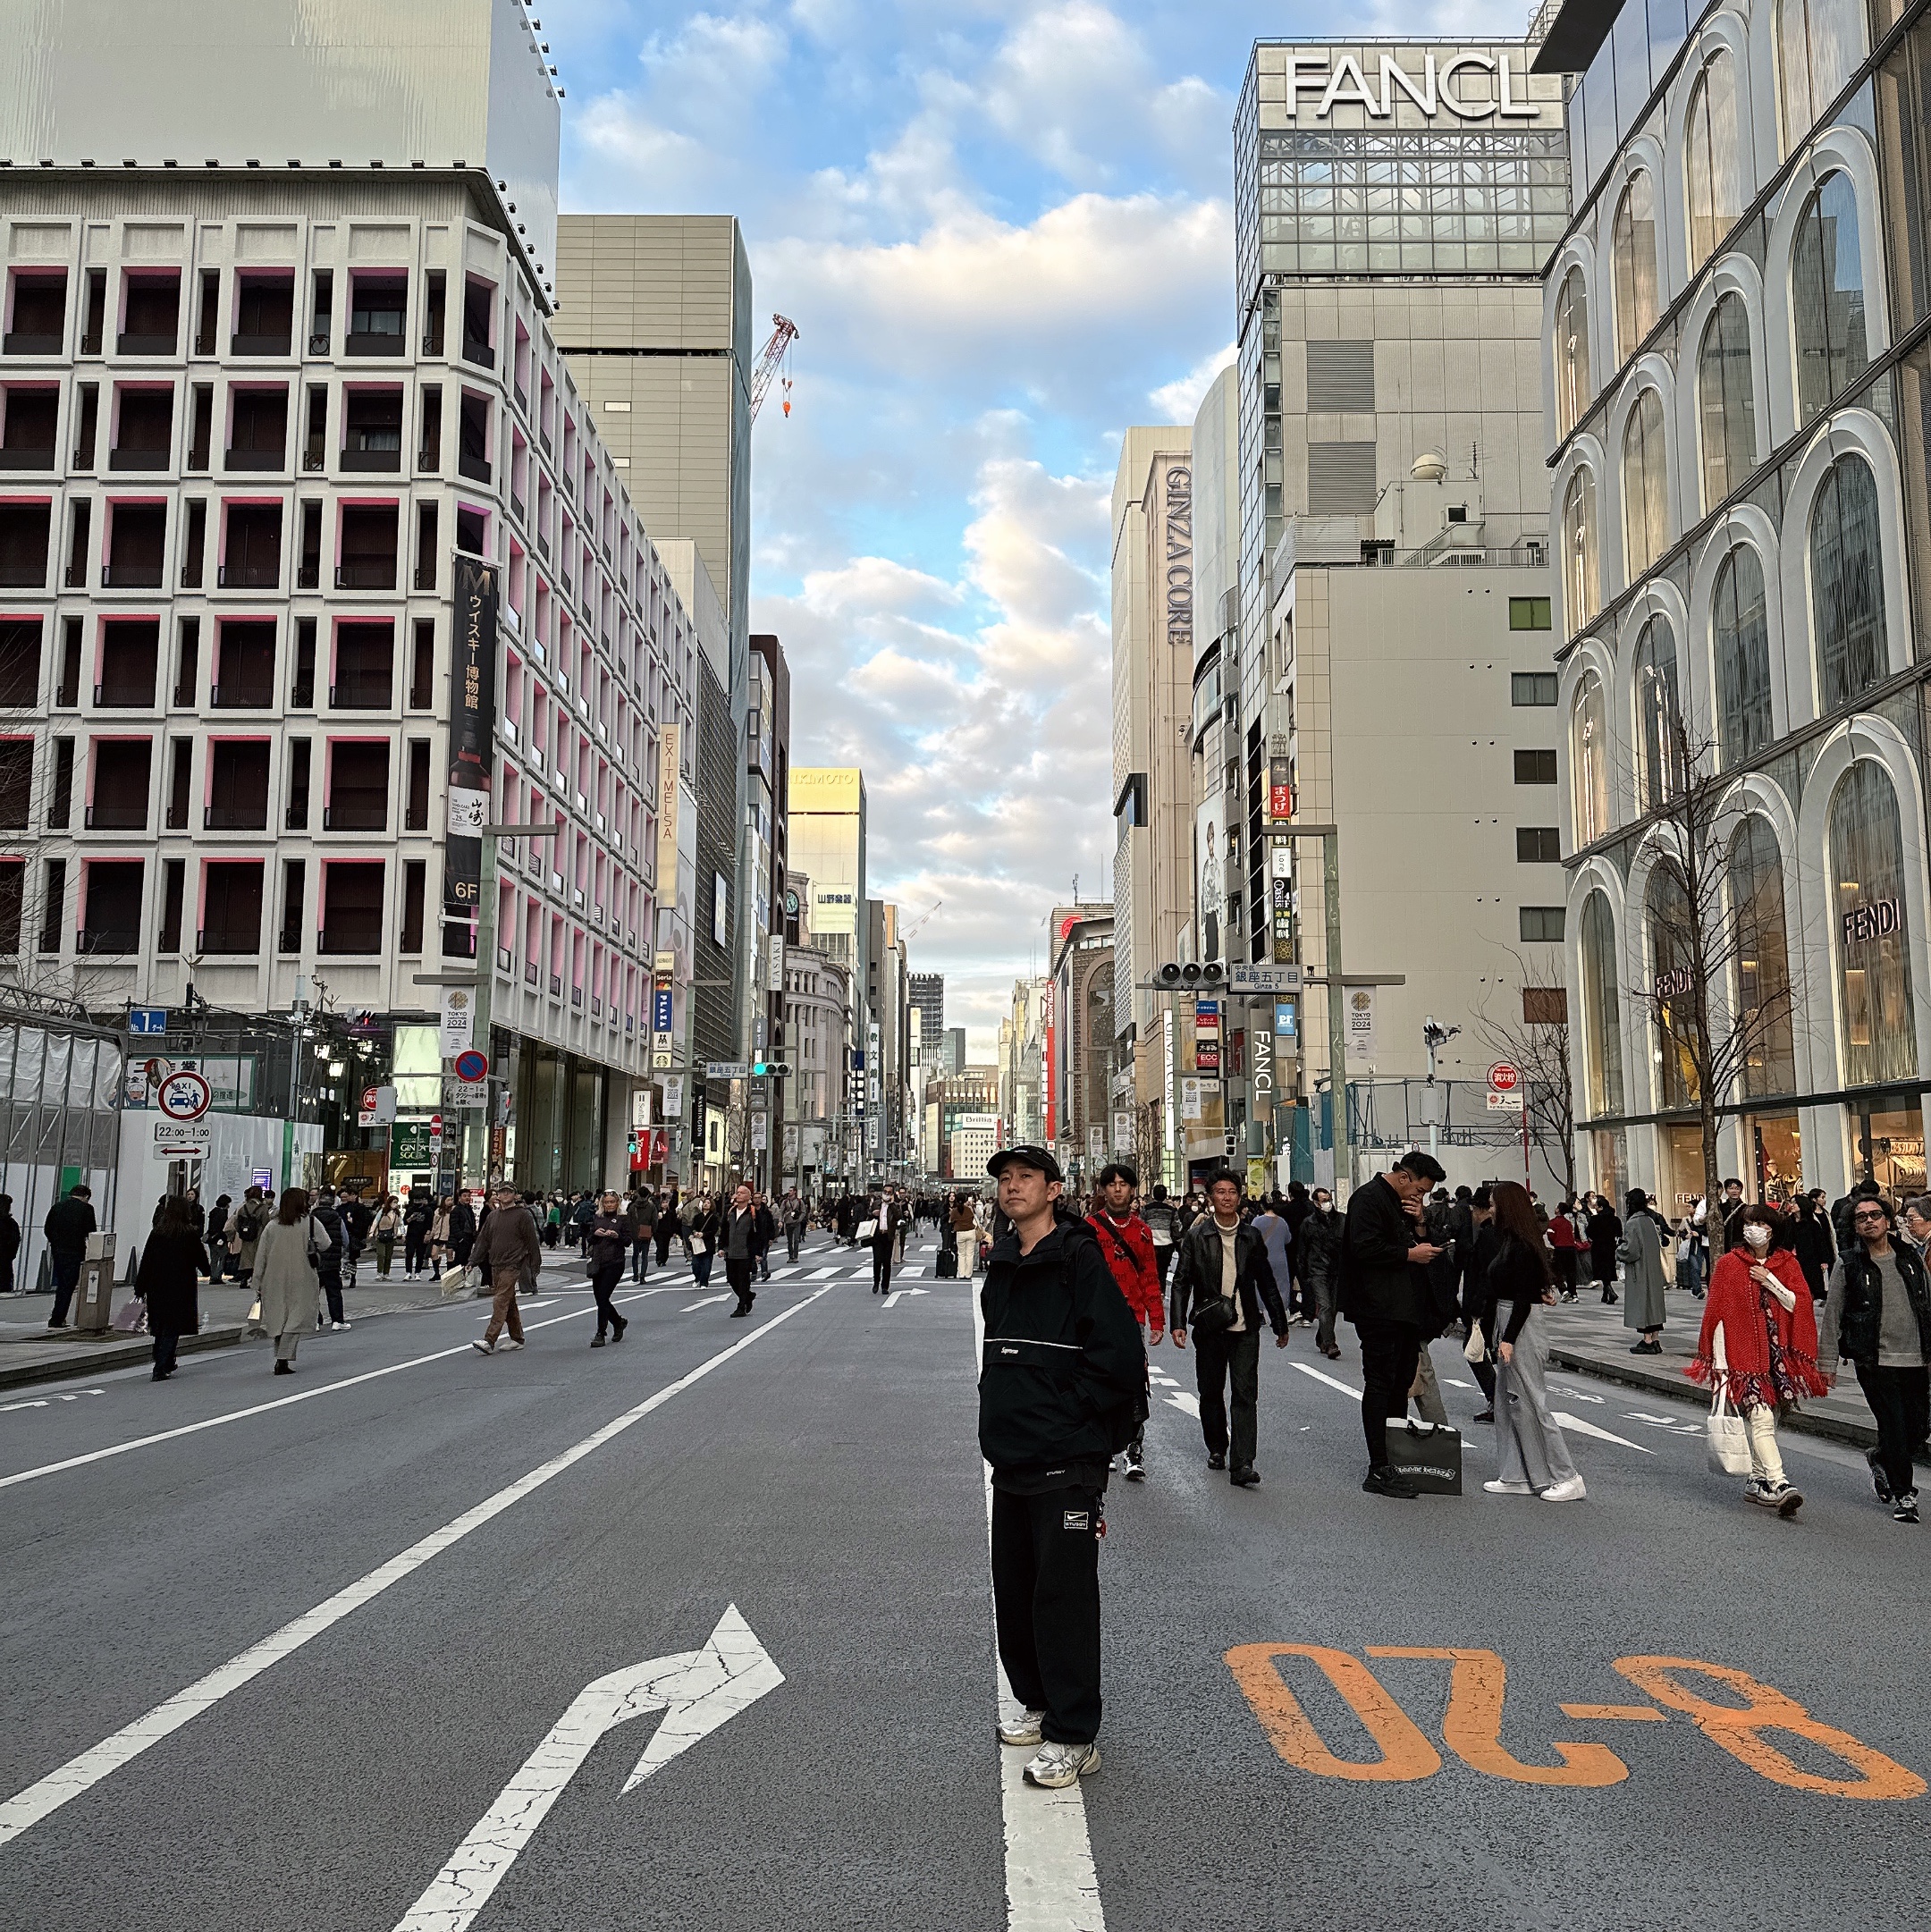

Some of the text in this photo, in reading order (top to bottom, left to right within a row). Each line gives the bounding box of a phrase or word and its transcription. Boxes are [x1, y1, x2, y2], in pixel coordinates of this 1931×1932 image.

[1285, 52, 1540, 120] FANCL
[1166, 466, 1193, 645] GINZA CORE
[464, 595, 482, 711] ウイスキー博物館
[1273, 786, 1287, 812] まつげ
[454, 882, 478, 899] 6F
[1842, 899, 1901, 945] FENDI
[772, 941, 780, 984] TASAKI
[1235, 971, 1298, 983] 銀座五丁目
[1655, 965, 1695, 998] FENDI
[141, 1012, 150, 1032] 1
[659, 994, 668, 1027] PLAZA
[1254, 1031, 1272, 1101] FANCL
[1494, 1072, 1515, 1083] 消火栓
[1675, 1193, 1707, 1204] FEND
